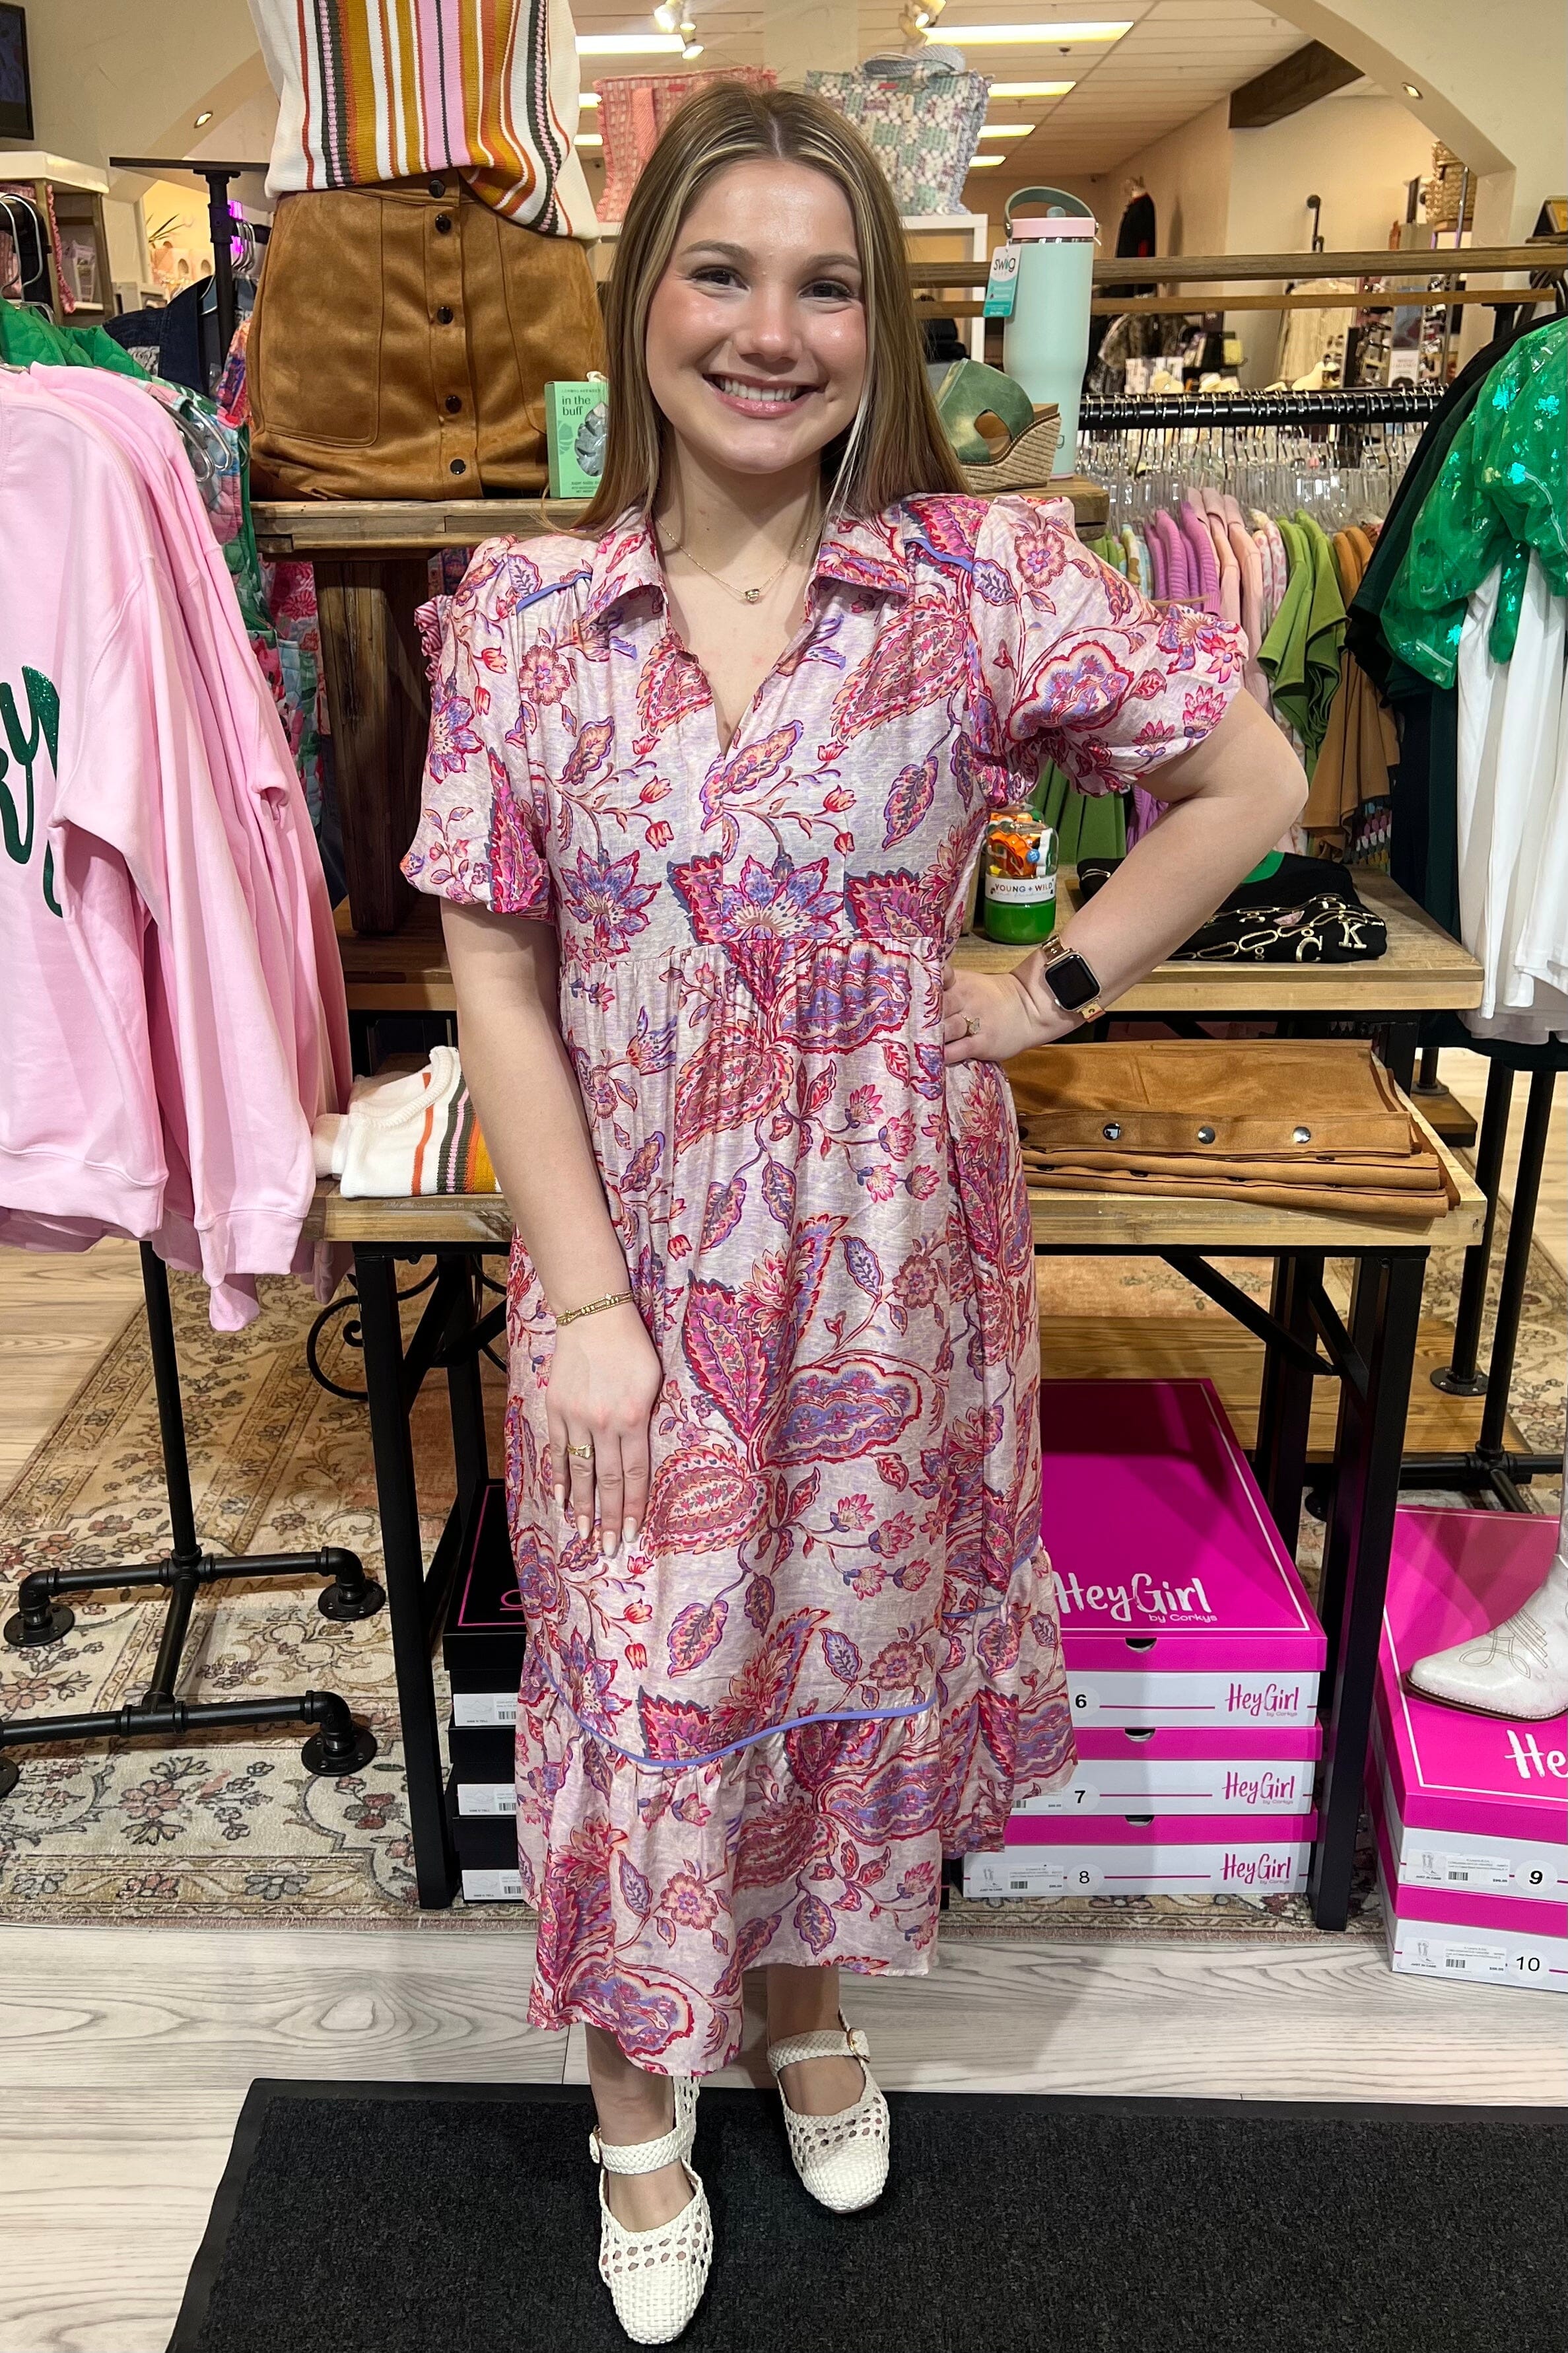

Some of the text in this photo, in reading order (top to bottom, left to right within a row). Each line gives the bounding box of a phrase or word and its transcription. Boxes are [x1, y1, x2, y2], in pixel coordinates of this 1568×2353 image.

[562, 395, 591, 405] in the
[562, 406, 583, 415] buff
[995, 883, 1025, 893] YOUNG
[1035, 882, 1052, 892] WILD
[1149, 1614, 1218, 1623] by Corkys
[1075, 1694, 1087, 1708] 6
[1074, 1790, 1086, 1804] 7
[1079, 1871, 1090, 1884] 8
[1529, 1870, 1543, 1885] 9
[1517, 1956, 1540, 1971] 10
